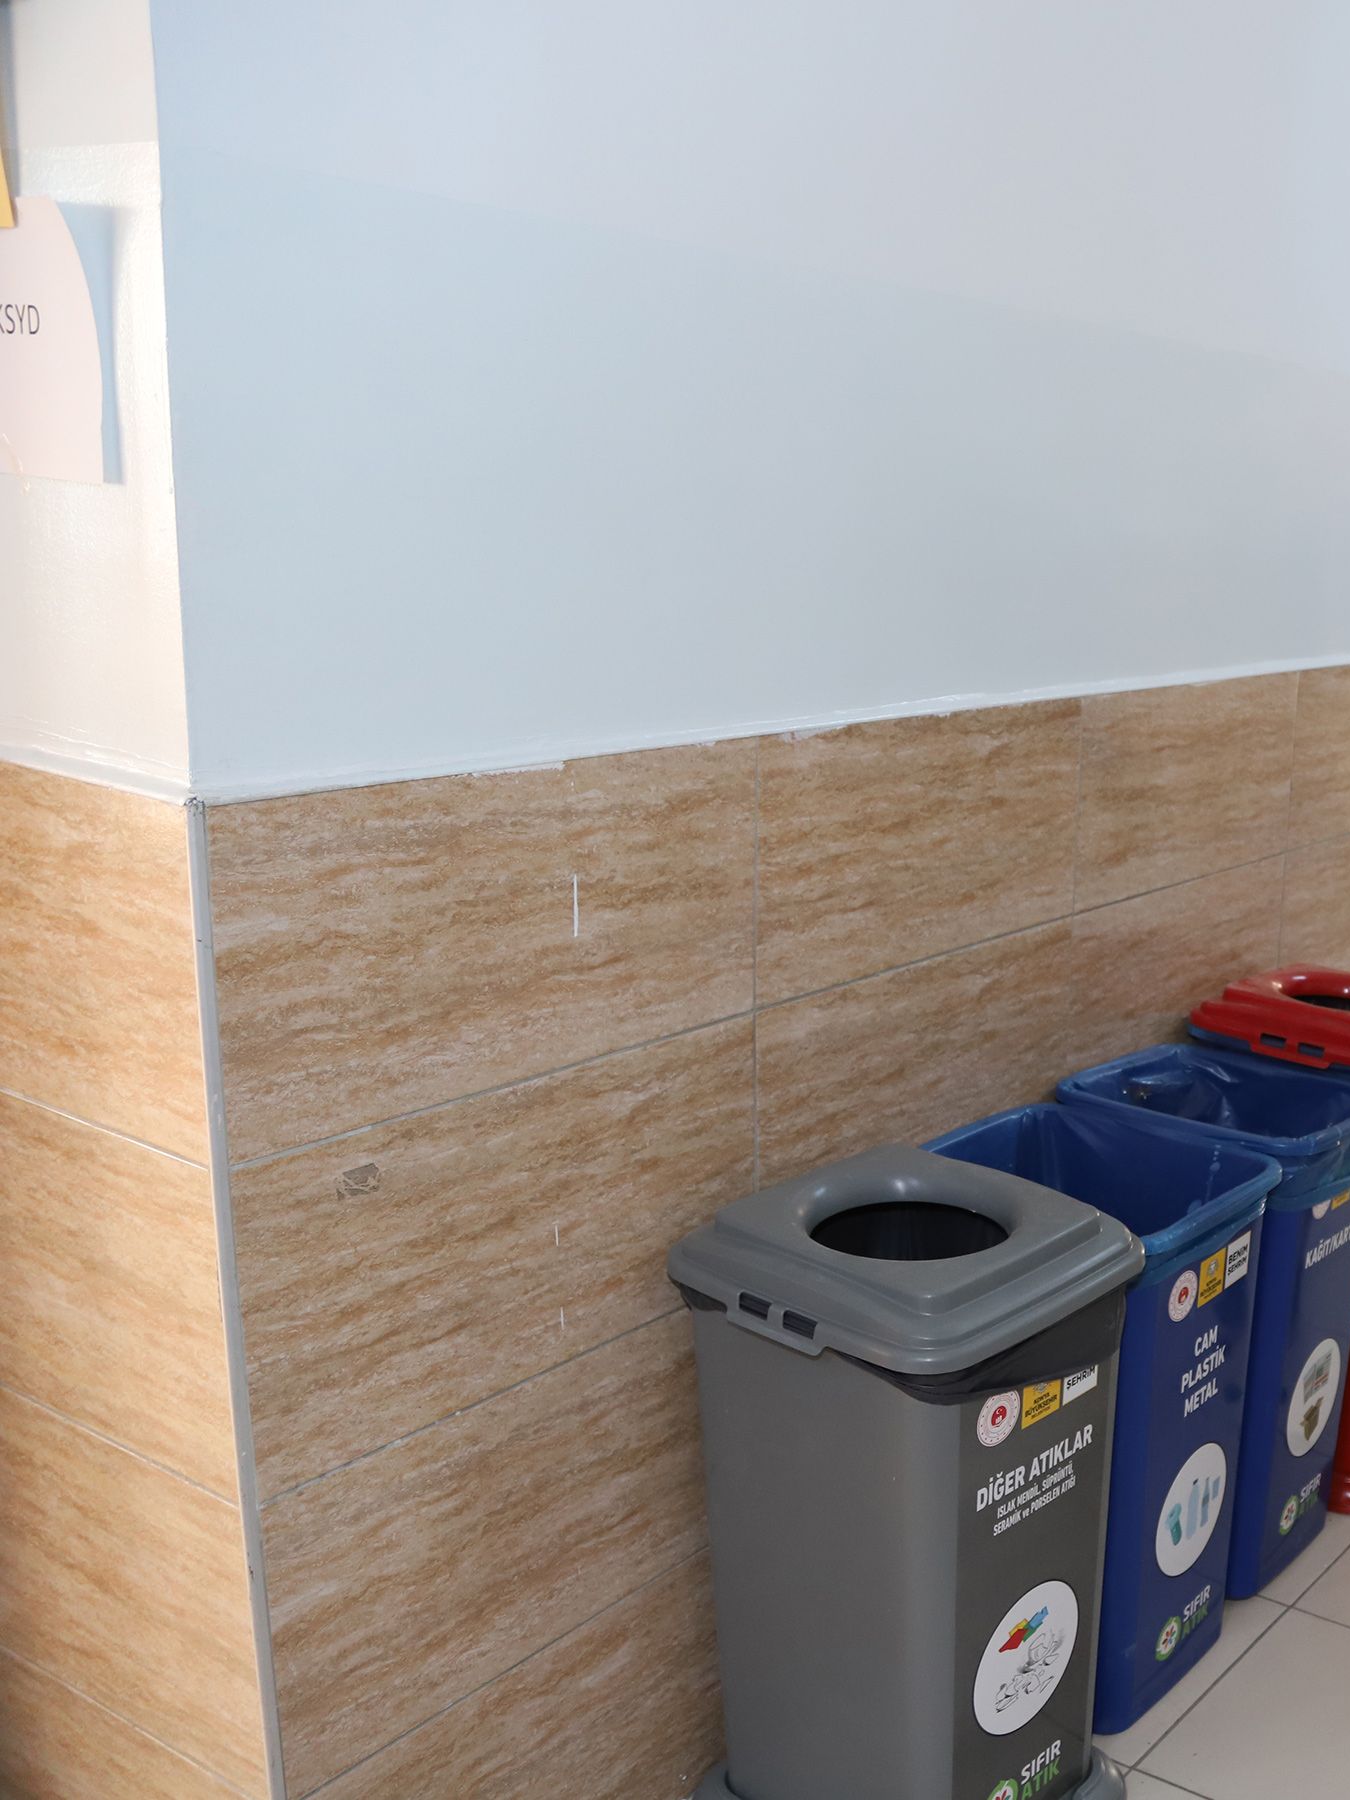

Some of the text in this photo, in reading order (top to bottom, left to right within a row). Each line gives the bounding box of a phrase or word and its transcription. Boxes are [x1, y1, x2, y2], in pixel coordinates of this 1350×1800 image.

[1194, 1325, 1218, 1357] CAM
[1180, 1344, 1226, 1393] PLASTİK
[1184, 1378, 1218, 1418] METAL
[976, 1423, 1093, 1513] DİĞER ATIKLAR
[1300, 1473, 1322, 1504] SIFIR
[993, 1475, 1077, 1537] SERAMİK ve PORSELEN ATIĞI
[997, 1497, 1016, 1519] ISLAK
[1183, 1585, 1211, 1623] SIFIR
[1021, 1739, 1061, 1785] SIFIR
[1021, 1757, 1060, 1800] ATIK
